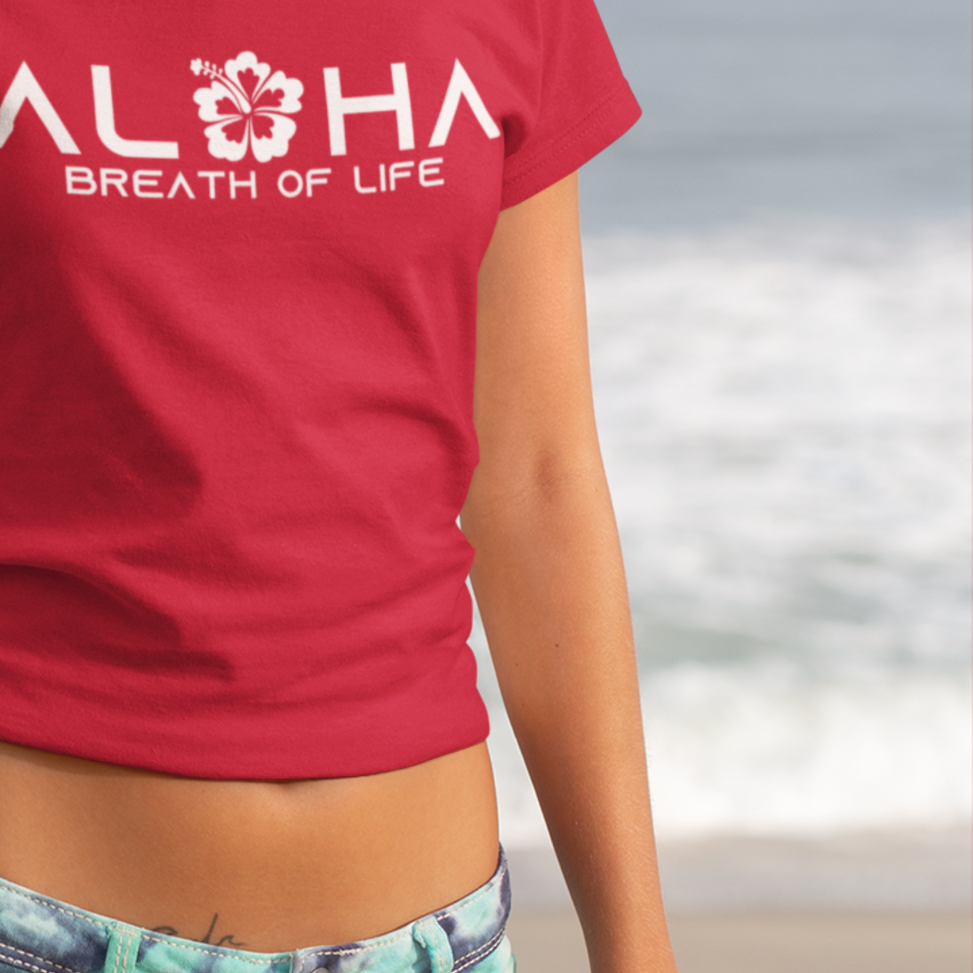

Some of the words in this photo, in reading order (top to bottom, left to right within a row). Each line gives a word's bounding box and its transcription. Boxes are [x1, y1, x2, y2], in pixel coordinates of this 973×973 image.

[64, 165, 258, 200] BREATH
[276, 168, 333, 198] OF
[353, 157, 445, 195] LIFE
